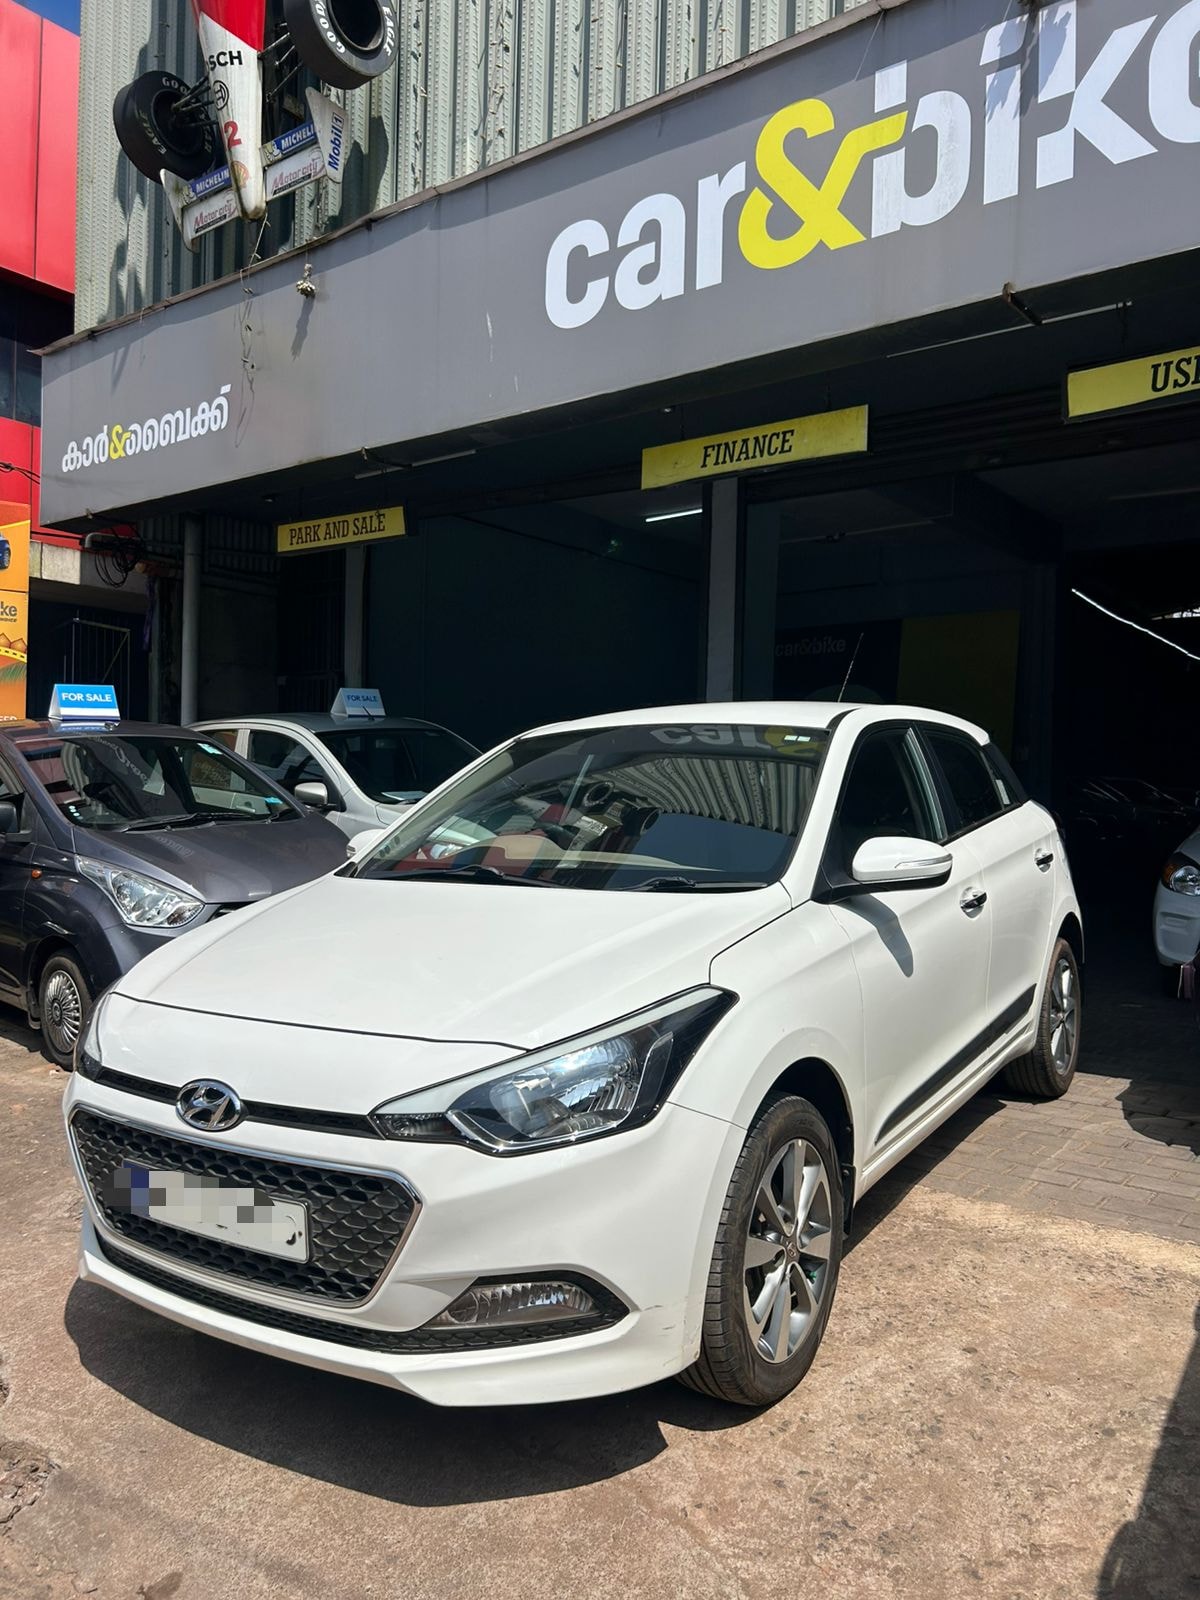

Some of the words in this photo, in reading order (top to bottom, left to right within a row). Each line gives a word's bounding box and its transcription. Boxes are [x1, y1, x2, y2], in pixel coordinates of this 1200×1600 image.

[315, 0, 345, 53] GOOD
[224, 121, 242, 149] 2
[282, 123, 314, 150] MICHELI
[700, 429, 795, 468] FINANCE
[289, 524, 321, 546] PARK
[324, 520, 349, 540] AND
[353, 513, 386, 536] SALE
[61, 692, 84, 702] FOR
[86, 693, 112, 703] SALE
